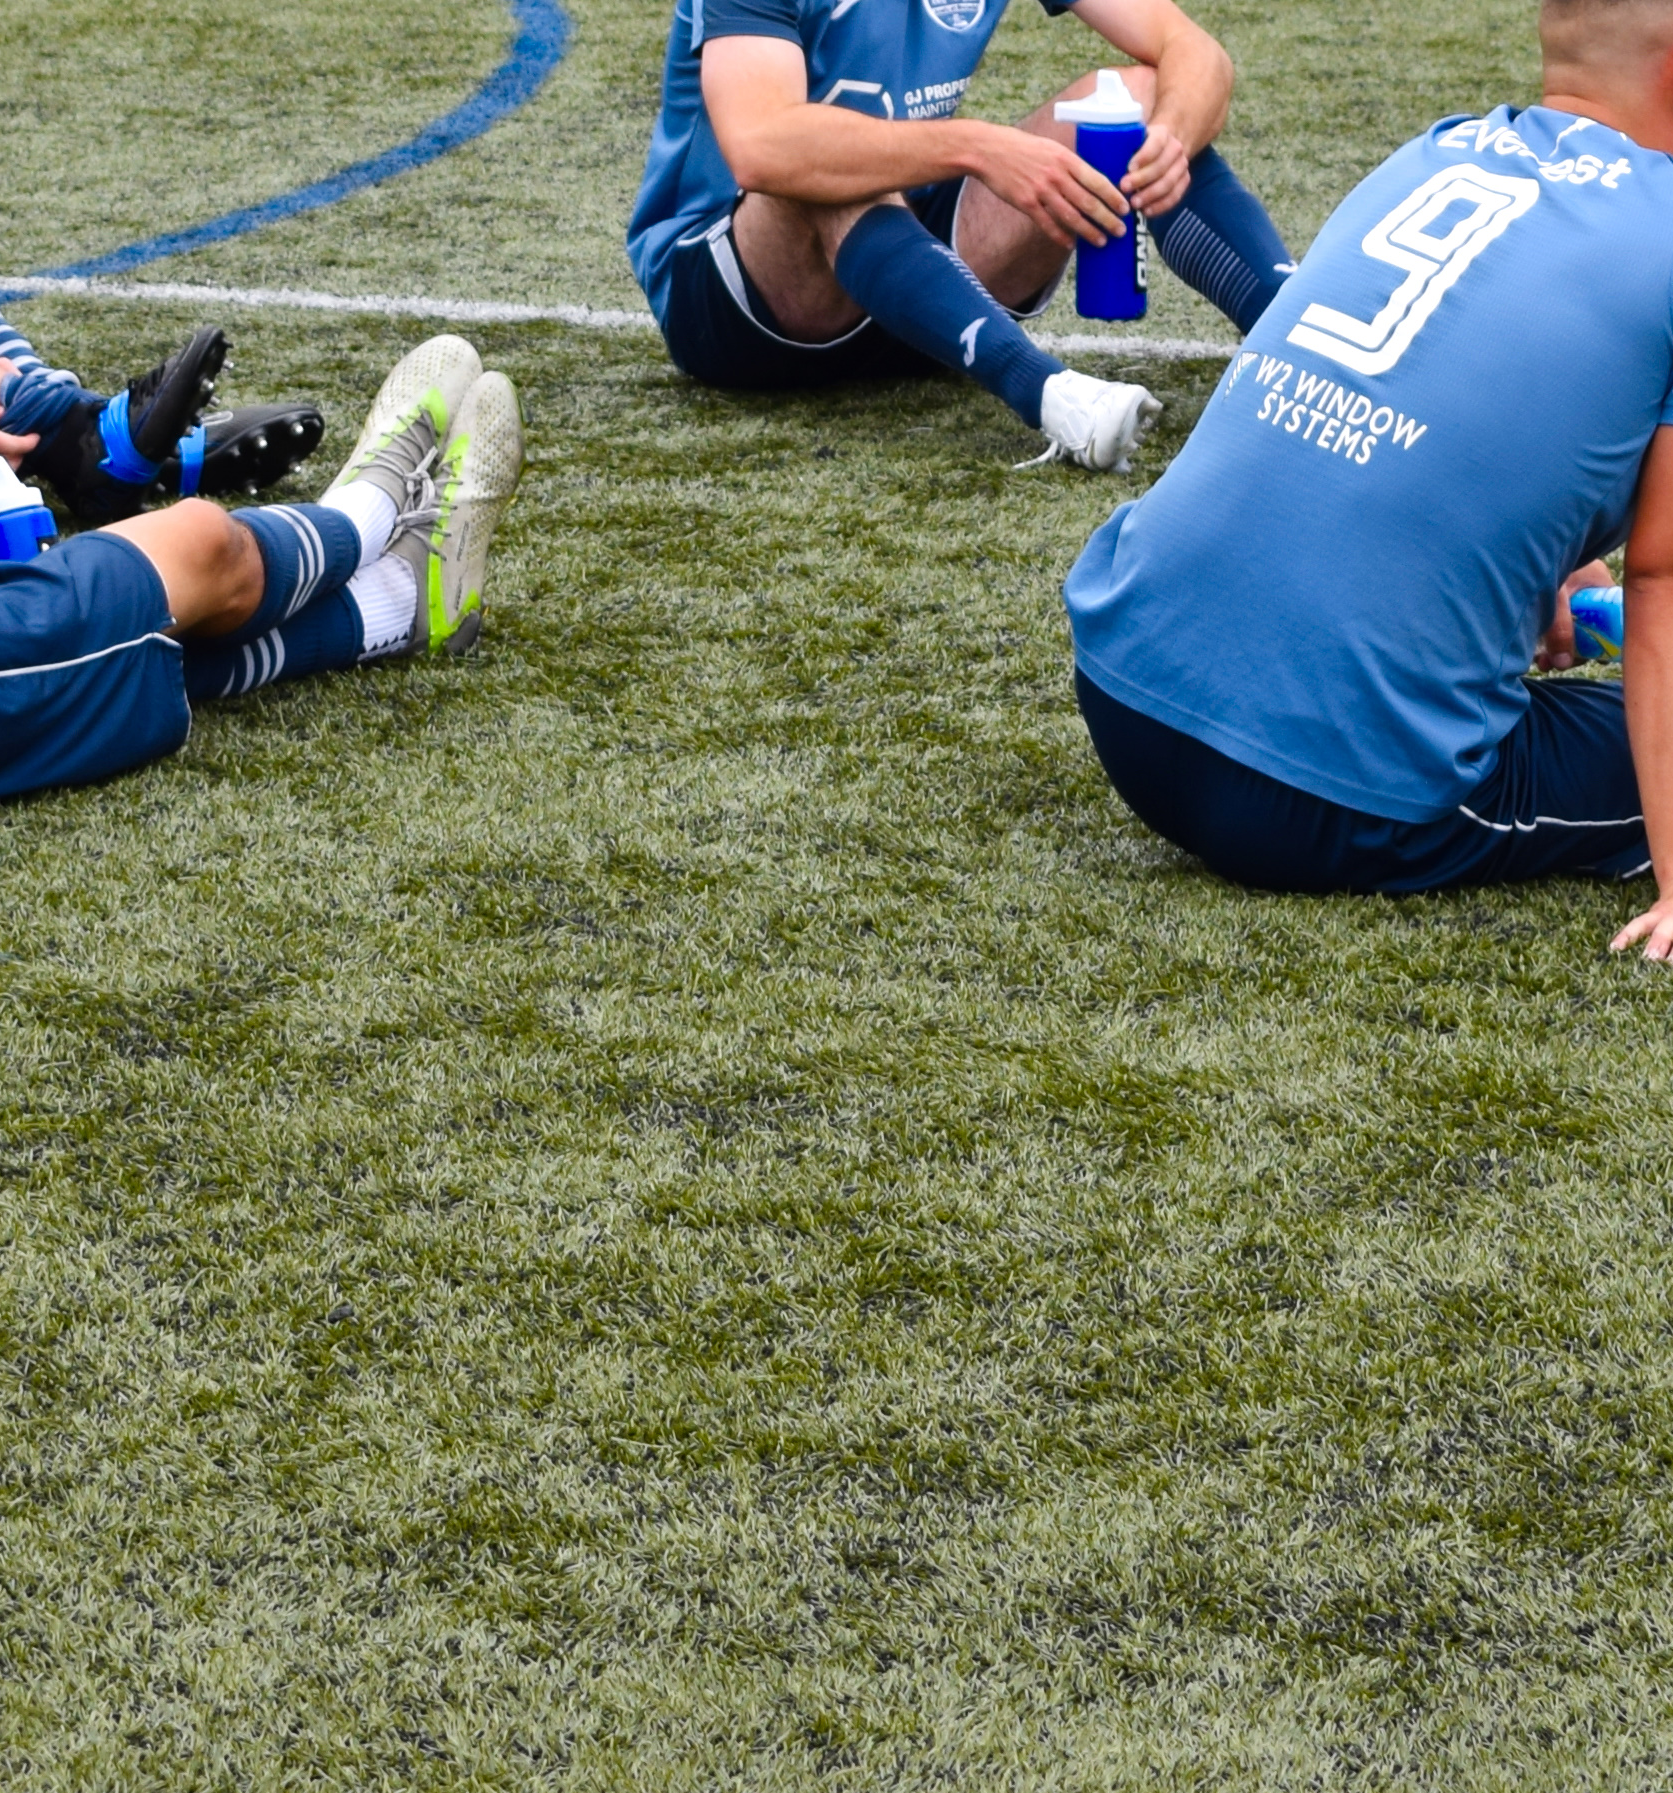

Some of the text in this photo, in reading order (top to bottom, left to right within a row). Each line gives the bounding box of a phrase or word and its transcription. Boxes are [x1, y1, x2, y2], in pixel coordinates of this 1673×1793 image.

[904, 77, 972, 106] GJ PROPE
[1286, 163, 1539, 376] 9
[1255, 355, 1428, 450] W2 WINDOW
[1257, 392, 1378, 465] SYSTEMS
